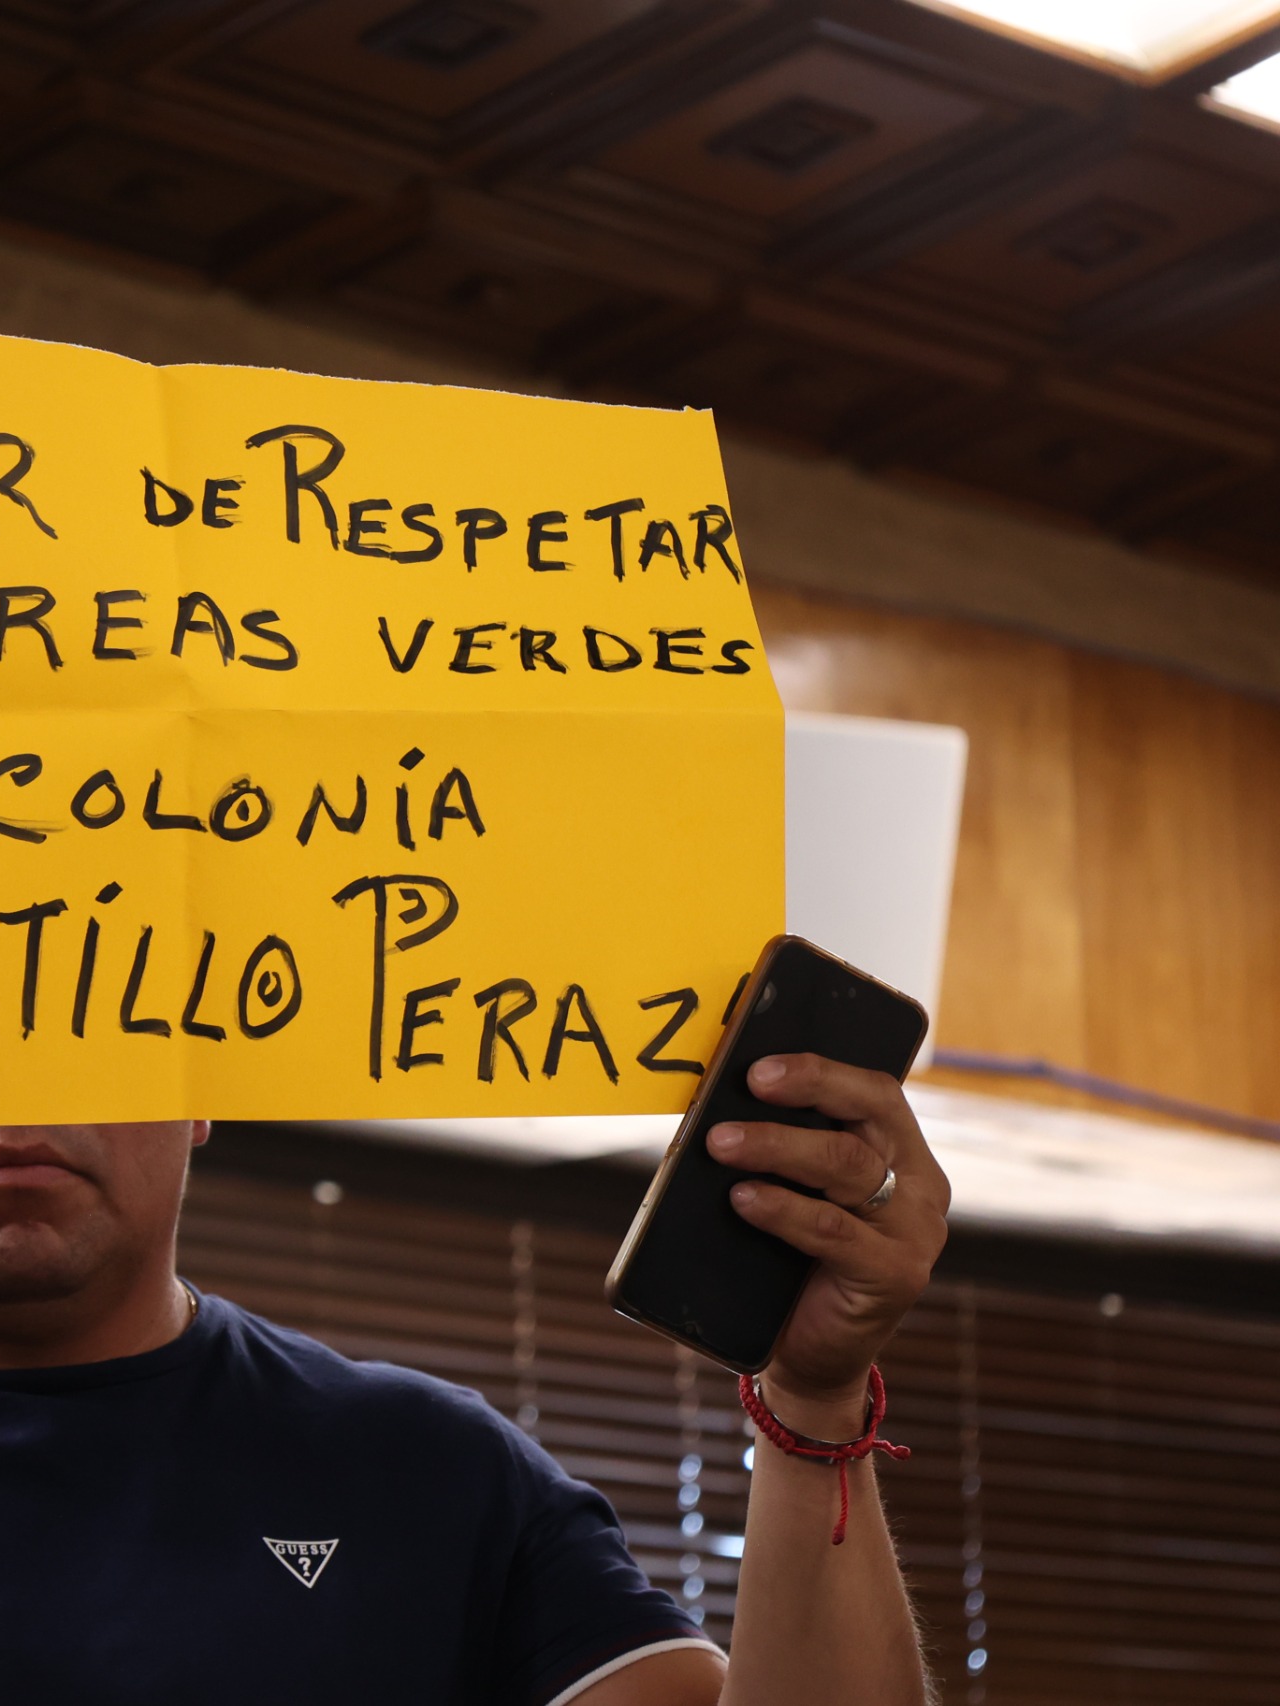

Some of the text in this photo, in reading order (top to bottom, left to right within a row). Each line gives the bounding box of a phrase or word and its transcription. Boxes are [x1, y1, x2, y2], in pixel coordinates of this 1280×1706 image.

[140, 467, 246, 529] DE
[245, 424, 742, 585] RESPETAR
[378, 616, 756, 676] VERDES
[331, 874, 752, 1086] PERAZ
[275, 1543, 328, 1555] GUESS
